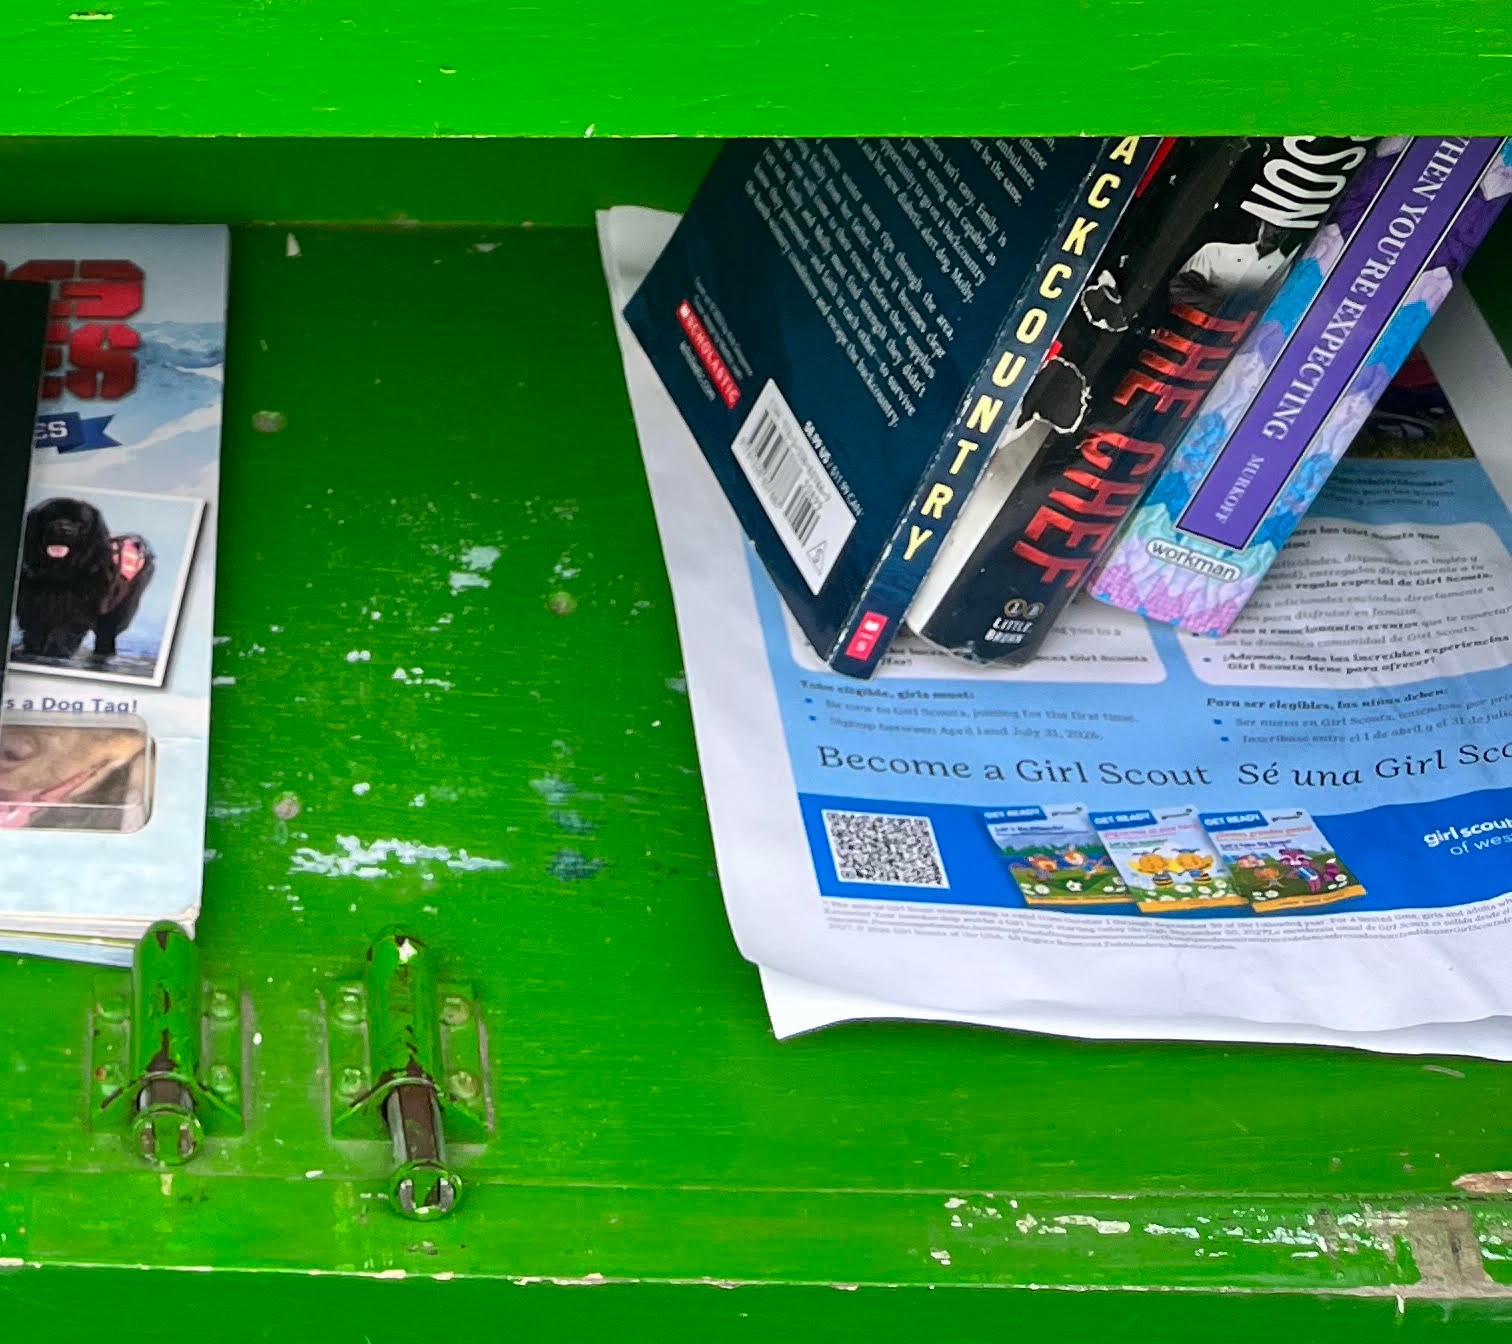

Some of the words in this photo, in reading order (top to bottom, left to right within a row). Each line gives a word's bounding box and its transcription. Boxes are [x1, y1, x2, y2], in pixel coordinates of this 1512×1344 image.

[1412, 136, 1470, 201] HEN
[975, 202, 1000, 237] Emily
[1350, 202, 1428, 298] YOU'RE
[903, 136, 1140, 562] ACKCOUNTRY
[1112, 303, 1261, 419] THE
[1261, 297, 1368, 441] EXPECTING
[1012, 427, 1166, 589] CHEF
[1215, 454, 1265, 525] MURKOFF
[1152, 541, 1236, 582] workman
[818, 745, 973, 779] Become
[984, 764, 1005, 781] a
[1015, 758, 1090, 784] Girl
[1100, 761, 1213, 787] Scout
[1238, 762, 1281, 786] Sé
[1293, 766, 1364, 788] una
[1375, 749, 1448, 780] Girl
[1424, 825, 1459, 849] girl
[1449, 839, 1469, 856] of
